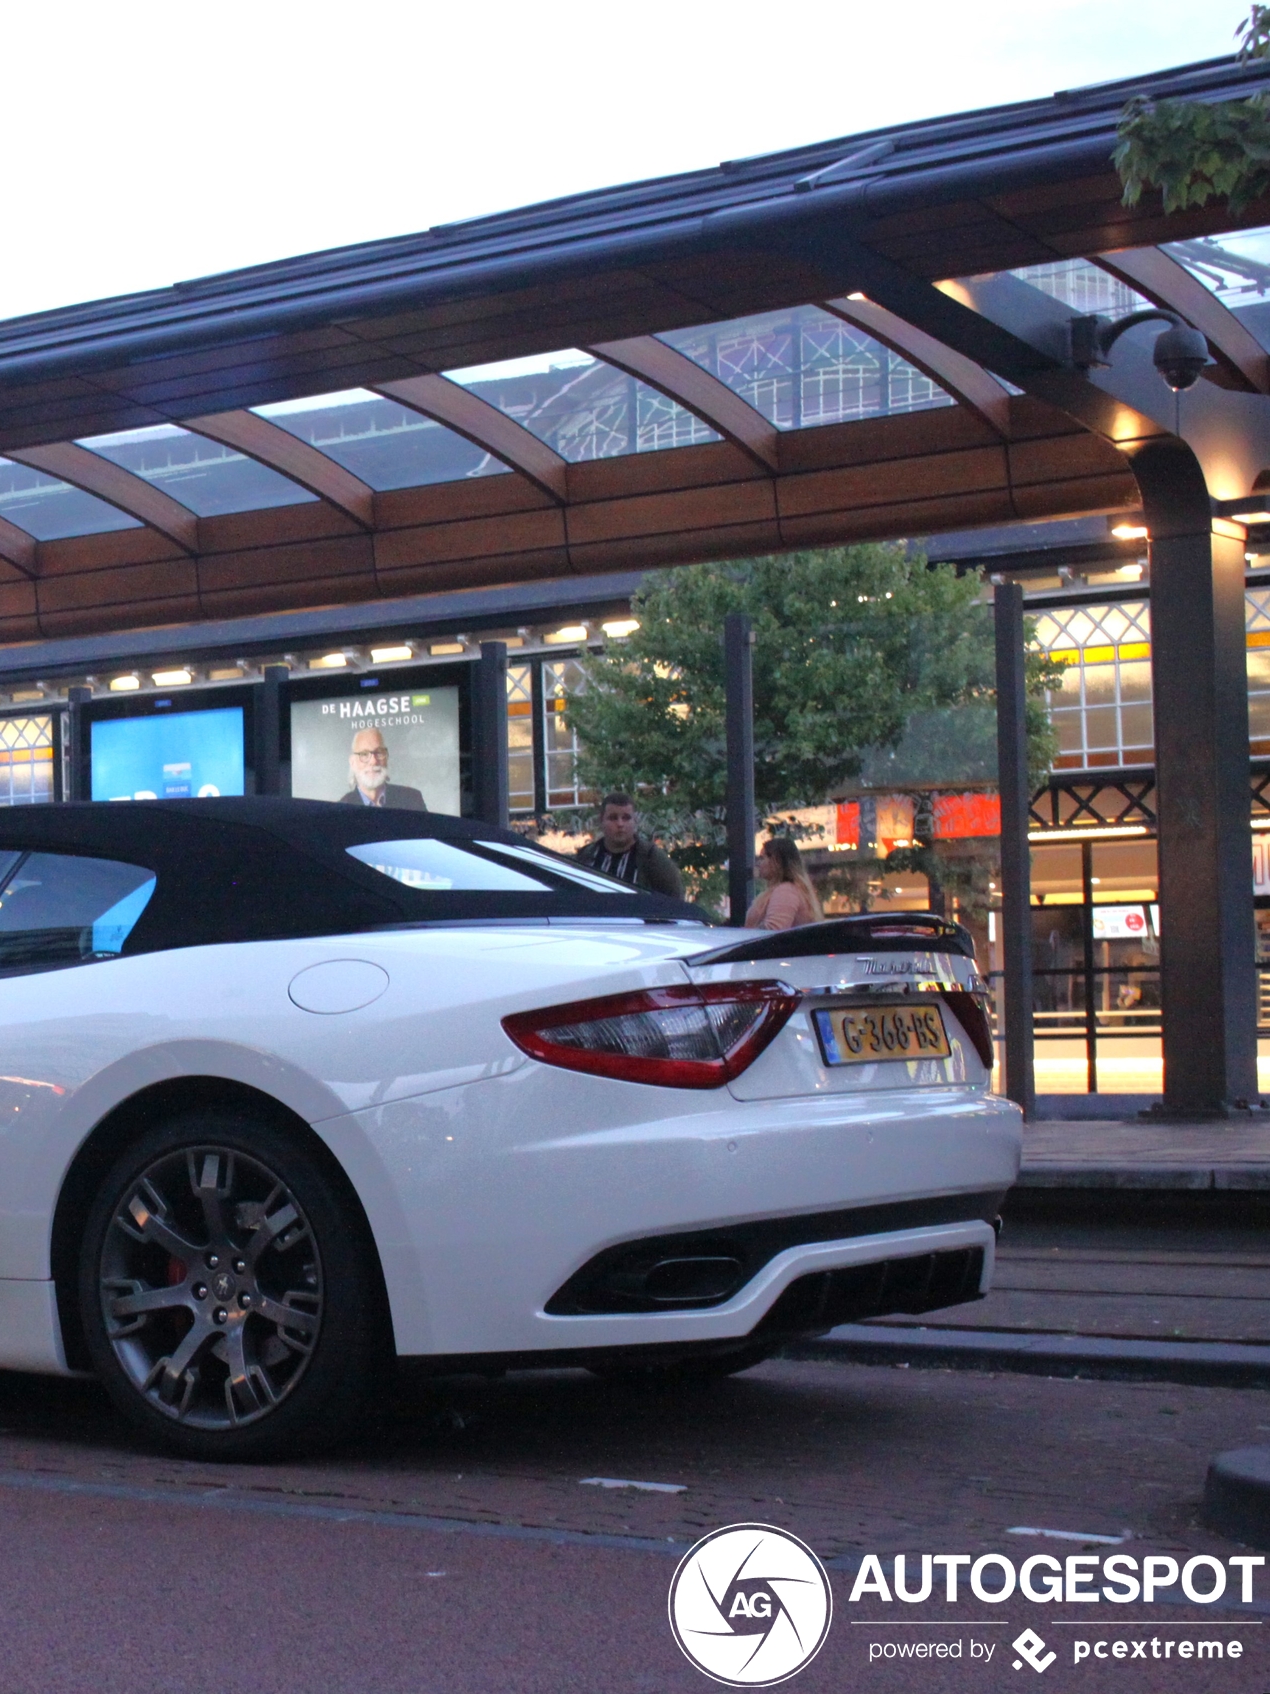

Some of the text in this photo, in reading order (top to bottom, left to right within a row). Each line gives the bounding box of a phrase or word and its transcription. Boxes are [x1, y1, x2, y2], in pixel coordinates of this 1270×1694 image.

[322, 696, 410, 719] DE HAAGSE
[351, 715, 424, 730] HOGESCHOOL
[842, 1013, 941, 1054] G-368-BS
